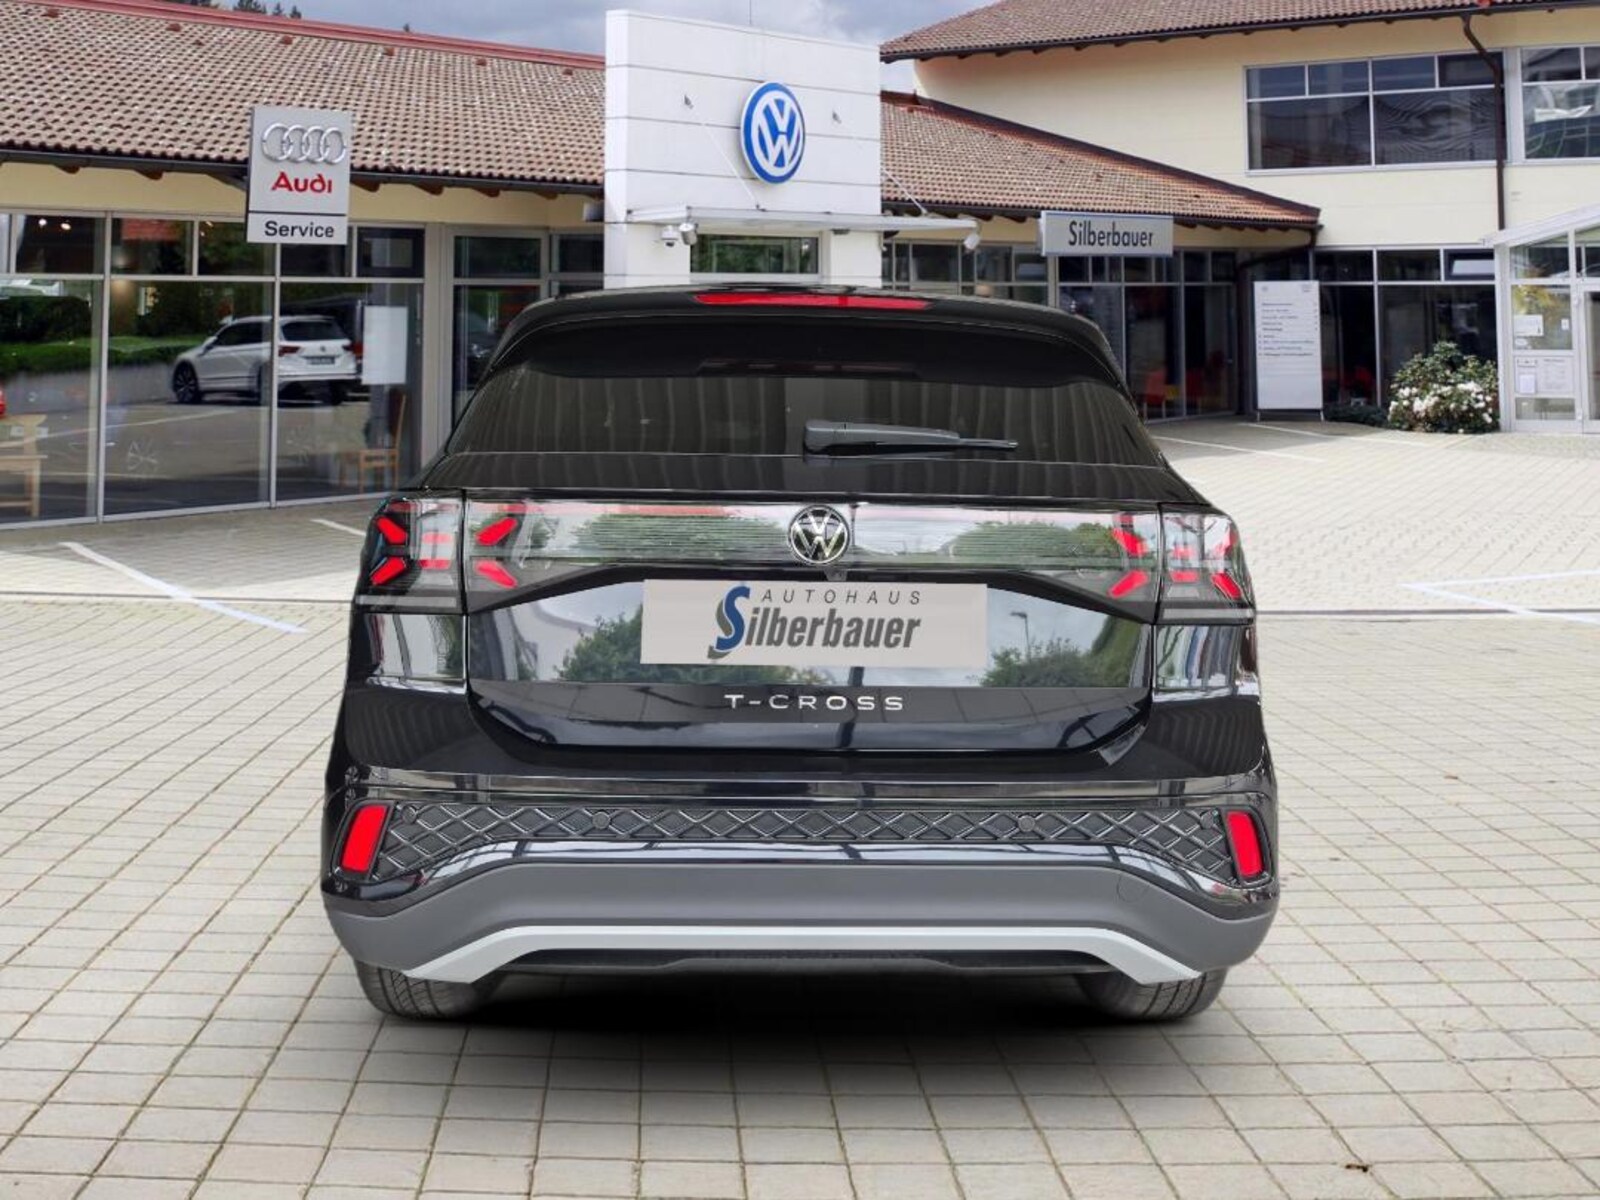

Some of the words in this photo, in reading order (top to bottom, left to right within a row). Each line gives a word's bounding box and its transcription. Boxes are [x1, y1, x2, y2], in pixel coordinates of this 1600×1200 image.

[271, 171, 332, 194] Audi
[264, 220, 335, 238] Service
[1068, 220, 1153, 247] Silberbauer
[761, 588, 922, 606] AUTOHAUS
[707, 586, 922, 659] Silberbauer
[724, 694, 904, 711] T-CROSS
